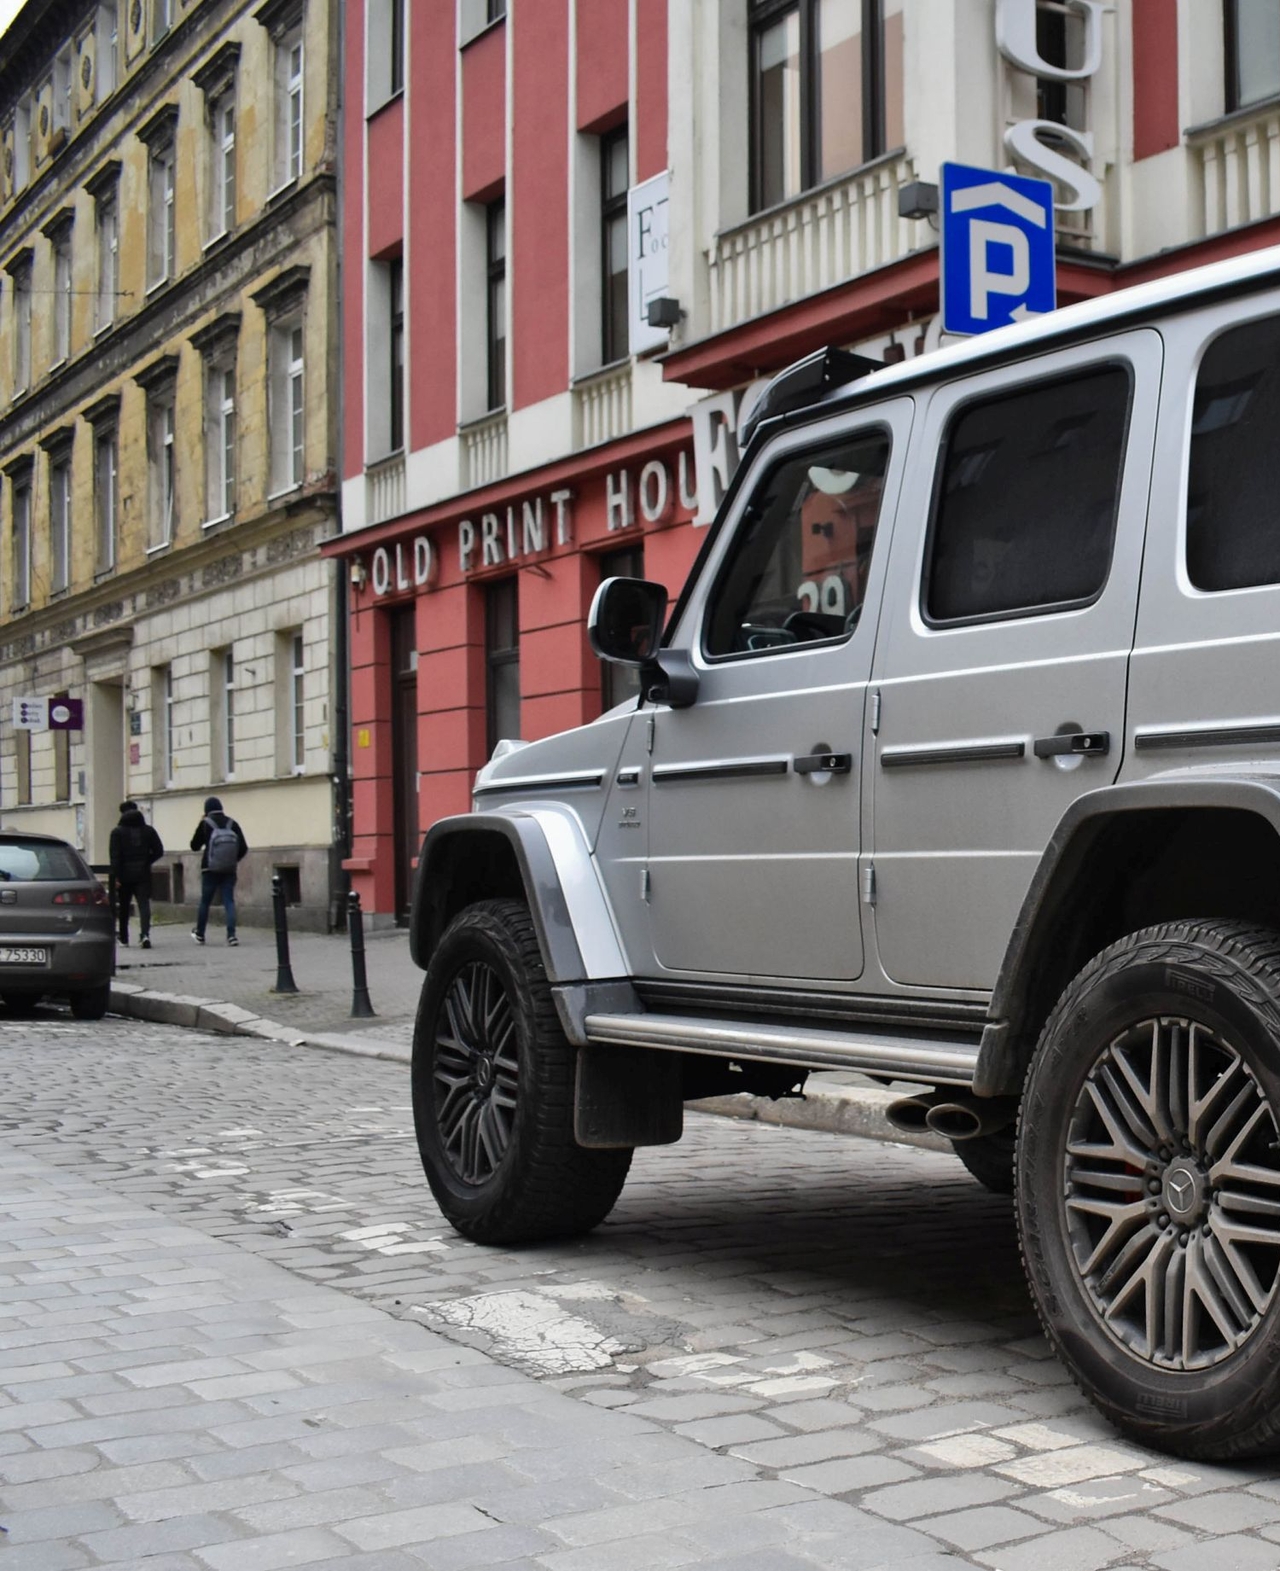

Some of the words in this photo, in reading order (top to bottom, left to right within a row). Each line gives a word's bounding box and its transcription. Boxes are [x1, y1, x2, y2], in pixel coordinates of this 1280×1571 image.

[969, 218, 1030, 320] P
[371, 535, 434, 597] OLD
[458, 489, 573, 573] PRINT
[6, 949, 45, 962] 75330
